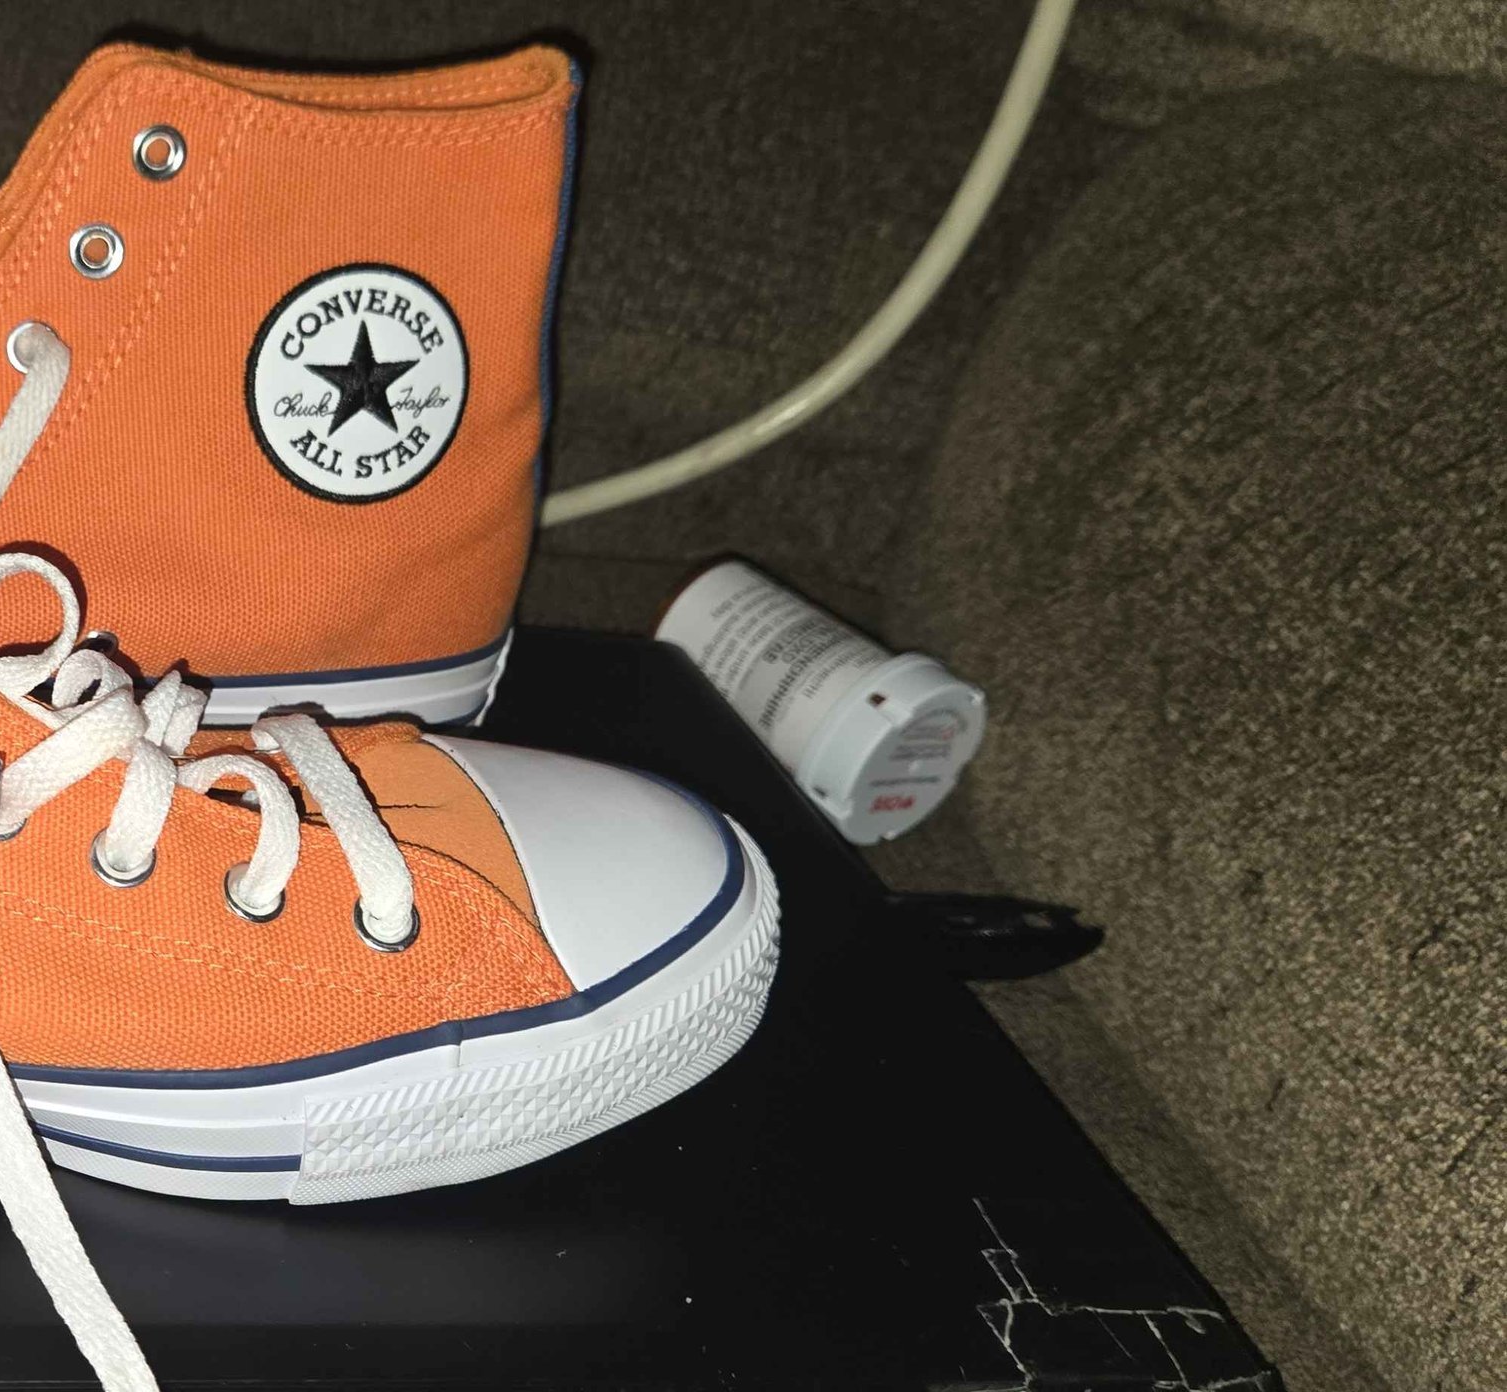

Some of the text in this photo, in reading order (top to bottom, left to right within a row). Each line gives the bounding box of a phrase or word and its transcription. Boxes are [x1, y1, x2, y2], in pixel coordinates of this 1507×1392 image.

[280, 288, 444, 361] CONVERSE
[273, 385, 451, 419] Chuck Taylor
[289, 425, 432, 480] ALL STAR
